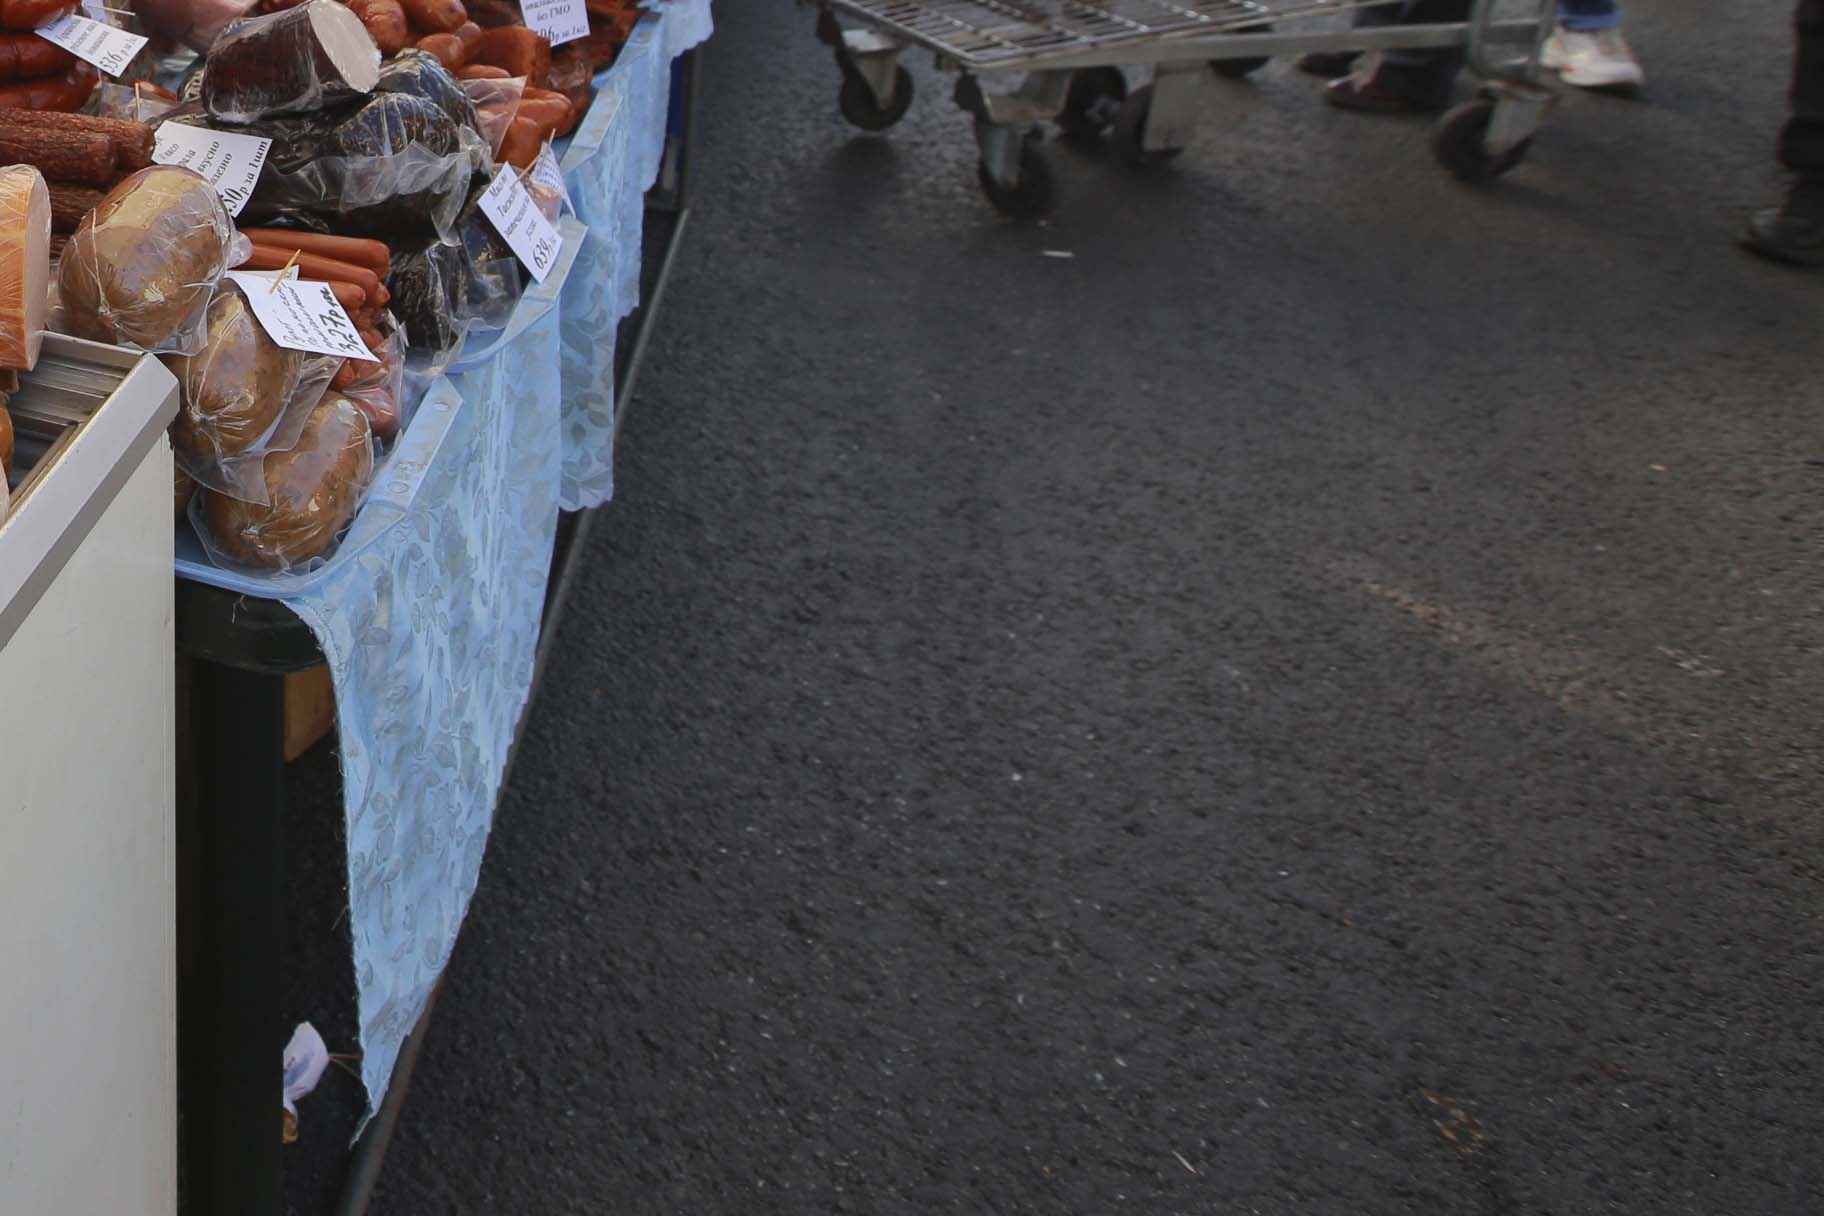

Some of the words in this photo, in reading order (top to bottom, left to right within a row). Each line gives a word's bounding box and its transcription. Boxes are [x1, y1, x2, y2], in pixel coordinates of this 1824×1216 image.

[550, 5, 571, 19] ГМО
[243, 173, 255, 187] за
[249, 141, 268, 168] 1шт
